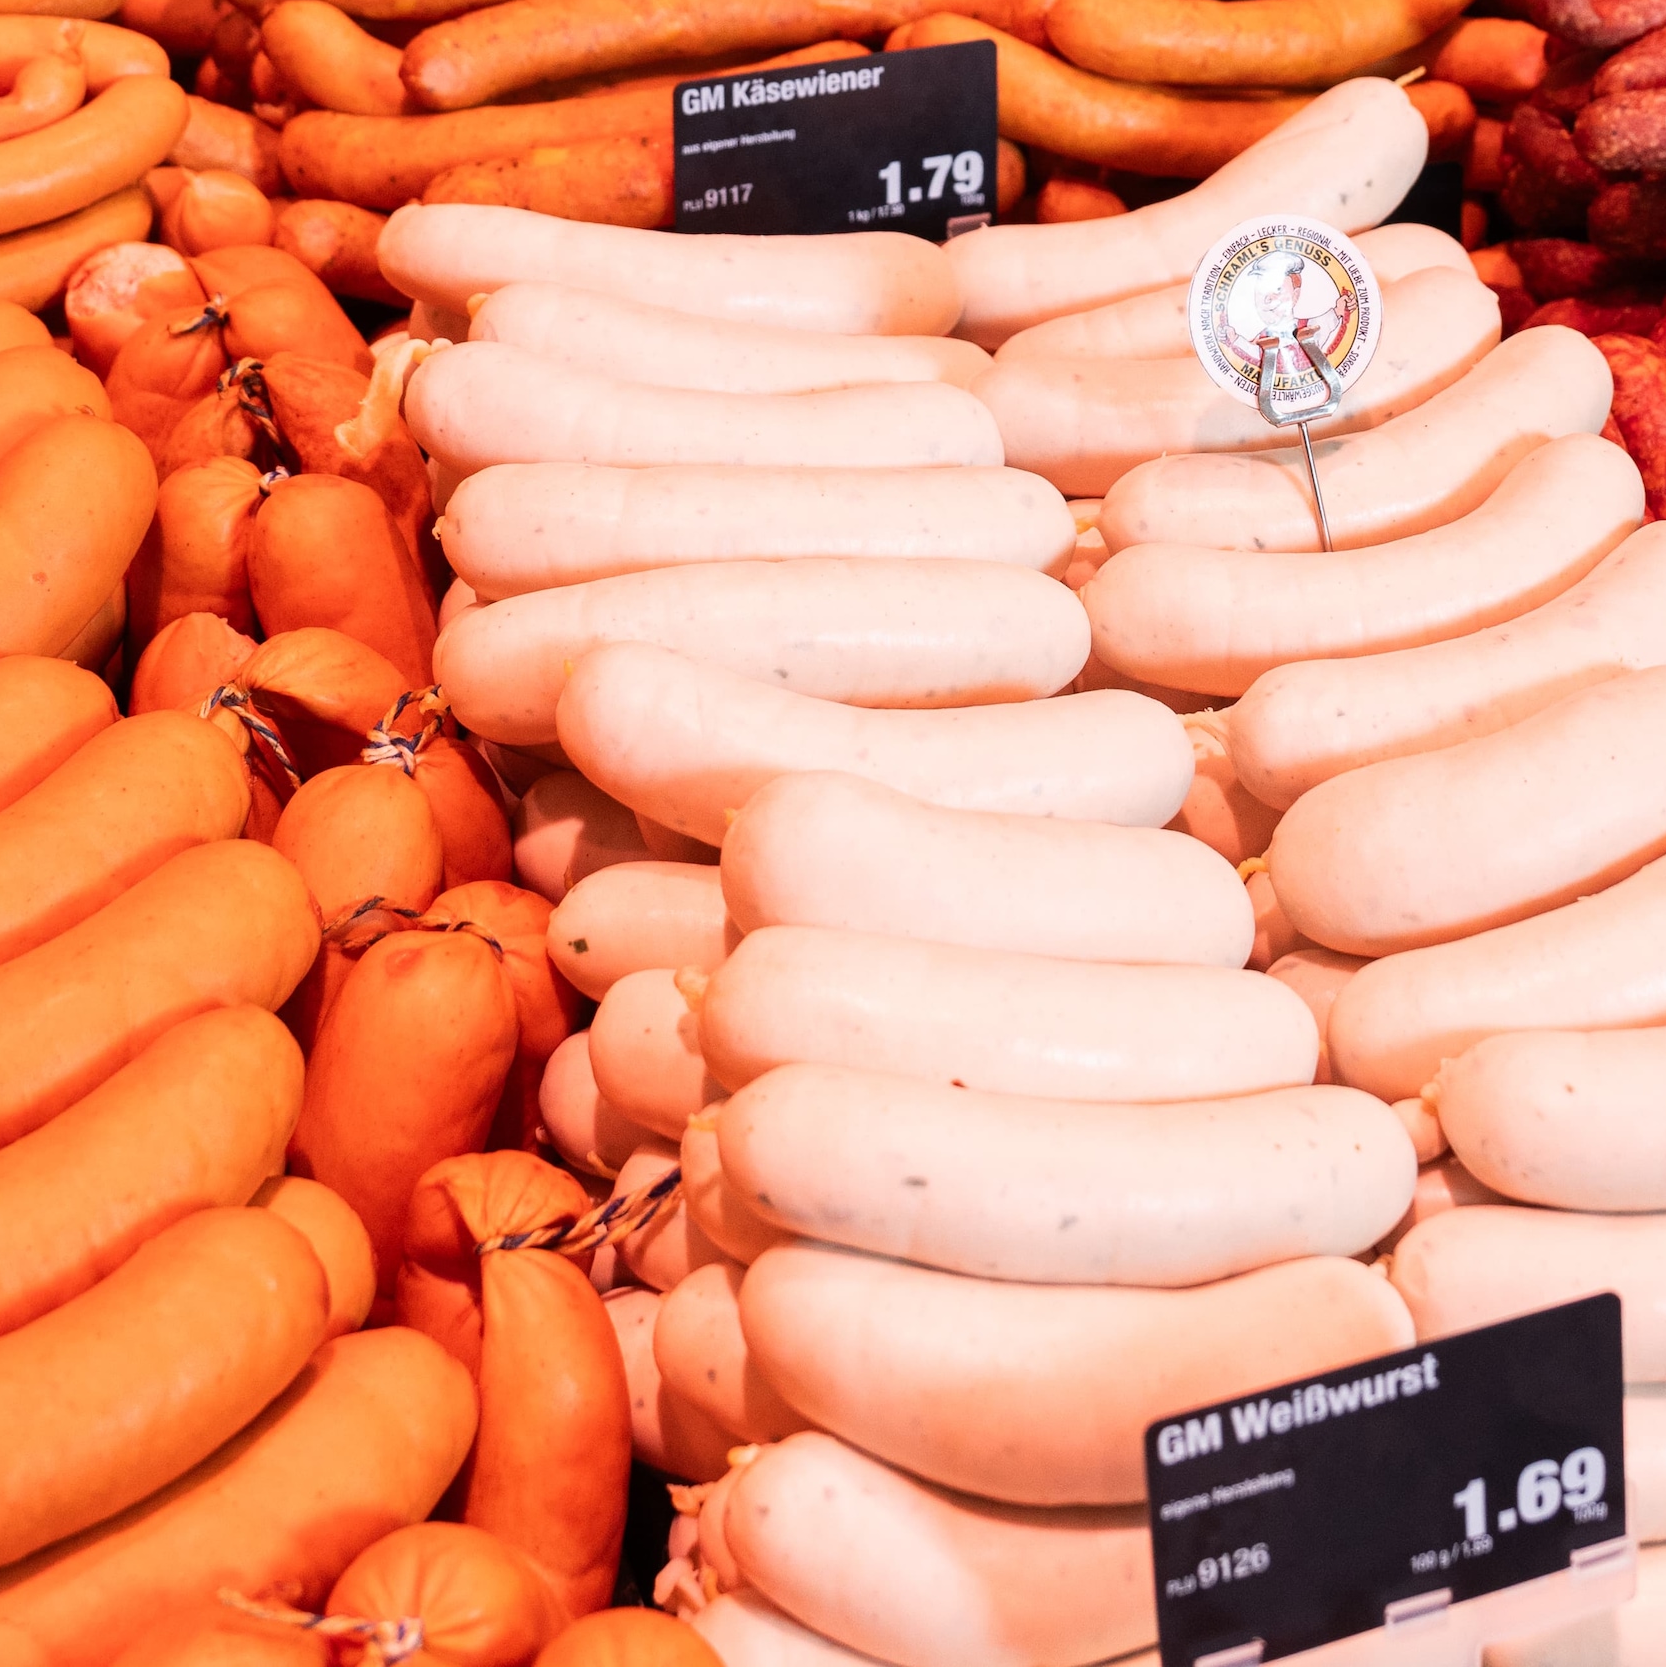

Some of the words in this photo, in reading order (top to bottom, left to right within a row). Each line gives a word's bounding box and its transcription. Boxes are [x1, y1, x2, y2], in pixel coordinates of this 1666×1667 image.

[681, 85, 725, 116] GM
[732, 65, 885, 109] Käsewiener
[878, 150, 984, 204] 1.79
[704, 183, 754, 209] 9117
[1257, 225, 1287, 237] LECKER
[1297, 227, 1331, 249] REGIONAL
[1222, 235, 1250, 259] EINFACH
[1274, 239, 1331, 267] GENUSS
[1337, 250, 1352, 265] MIT
[1201, 265, 1221, 305] TRADITION
[1348, 264, 1364, 286] LIEBE
[1358, 287, 1369, 304] ZUM
[1201, 310, 1211, 331] NACH
[1357, 306, 1370, 343] PRODUKT
[1203, 332, 1231, 375] HANDWERK
[1157, 1413, 1223, 1466] GM
[1231, 1352, 1440, 1445] Weißwurst
[1453, 1446, 1607, 1541] 1.69
[1197, 1542, 1271, 1589] 9126
